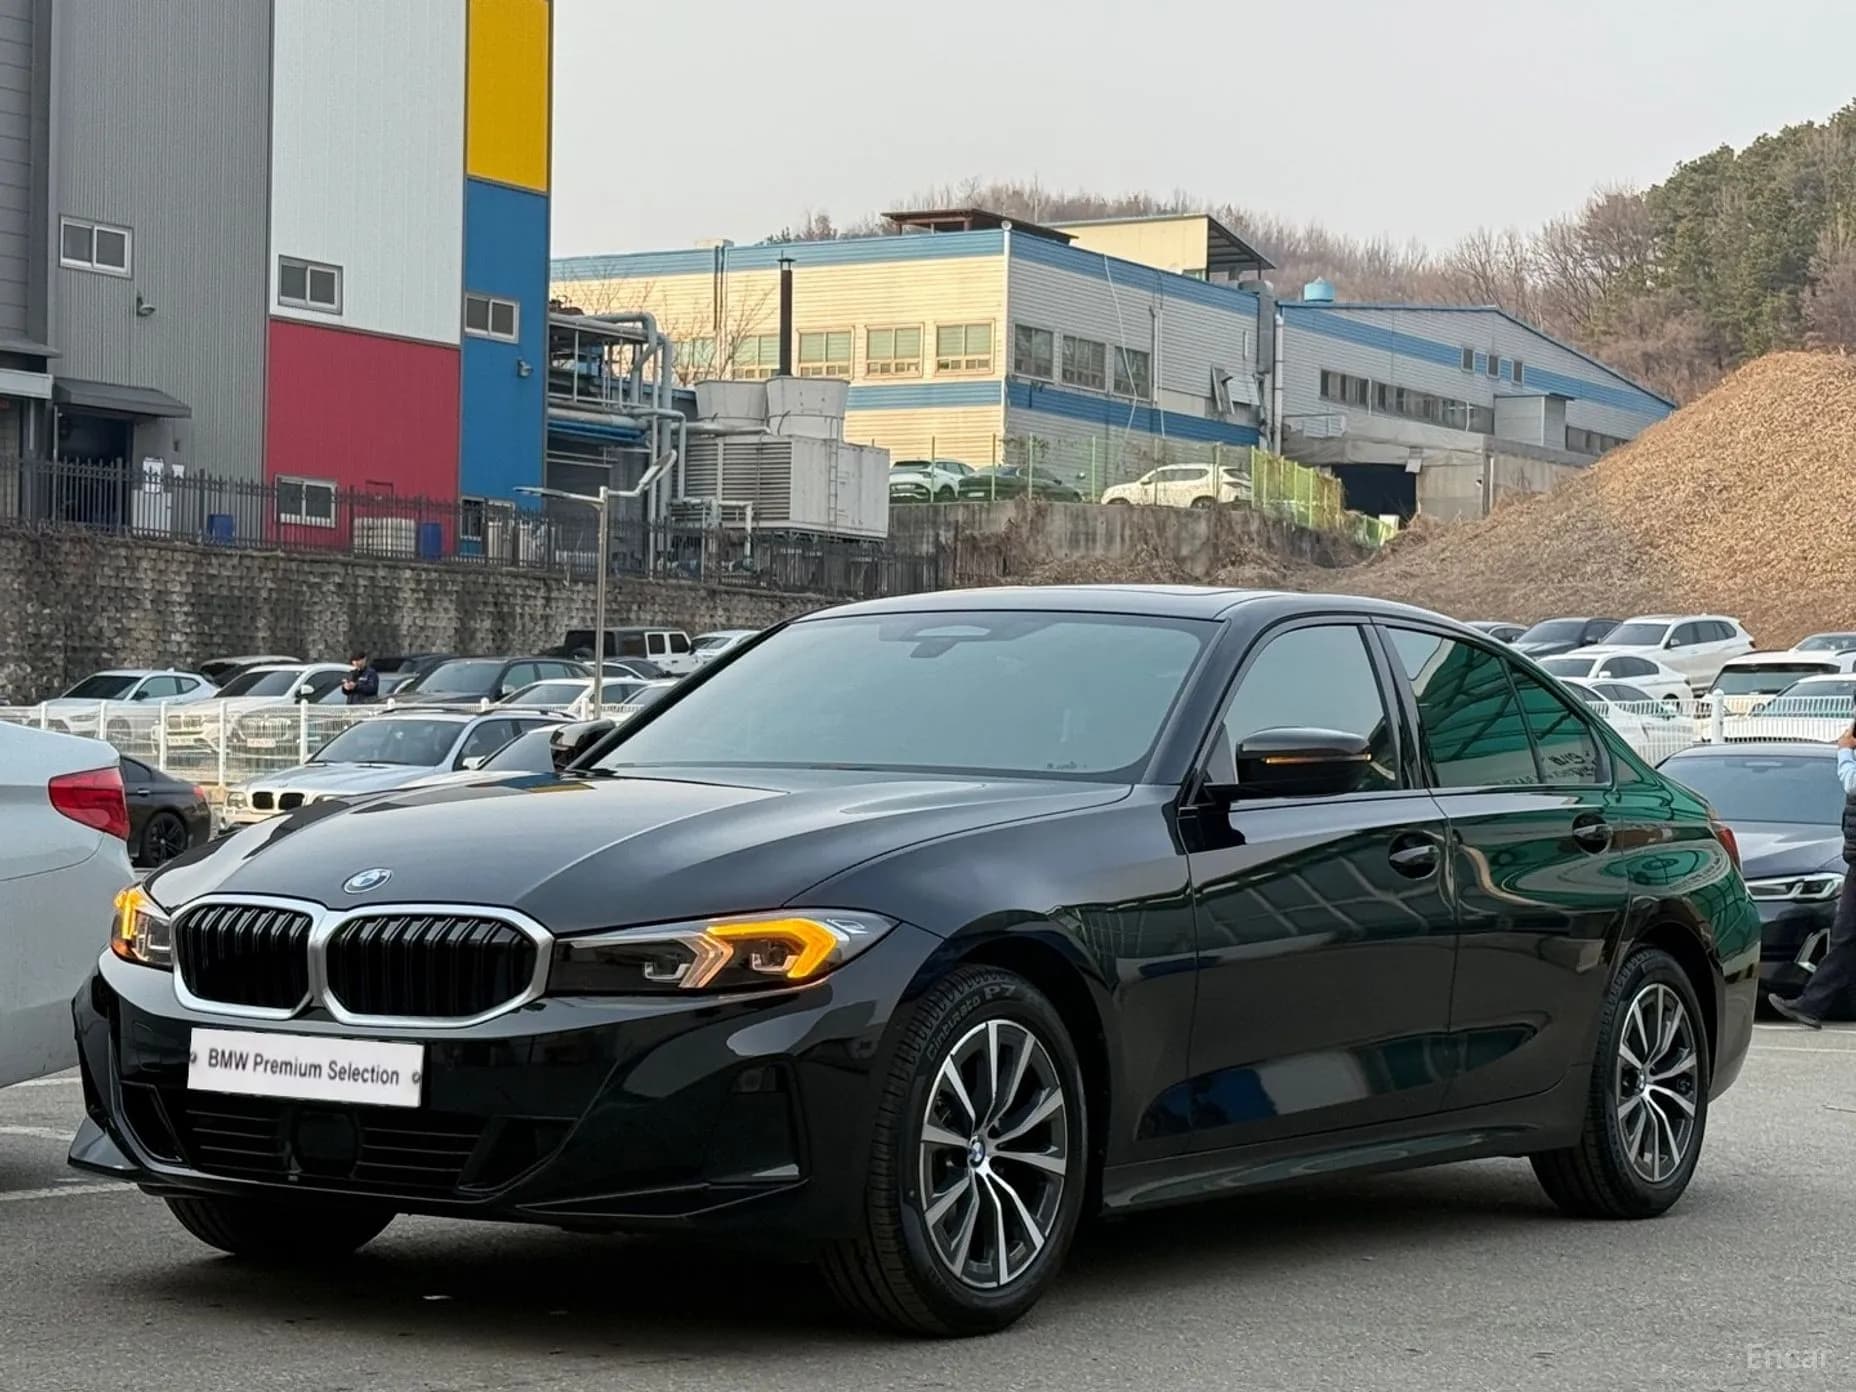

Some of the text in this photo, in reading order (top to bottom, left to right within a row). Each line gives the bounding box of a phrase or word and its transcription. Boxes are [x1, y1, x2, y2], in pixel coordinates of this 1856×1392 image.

[984, 984, 1016, 1000] P7
[208, 1048, 400, 1086] BMW Premium Selection
